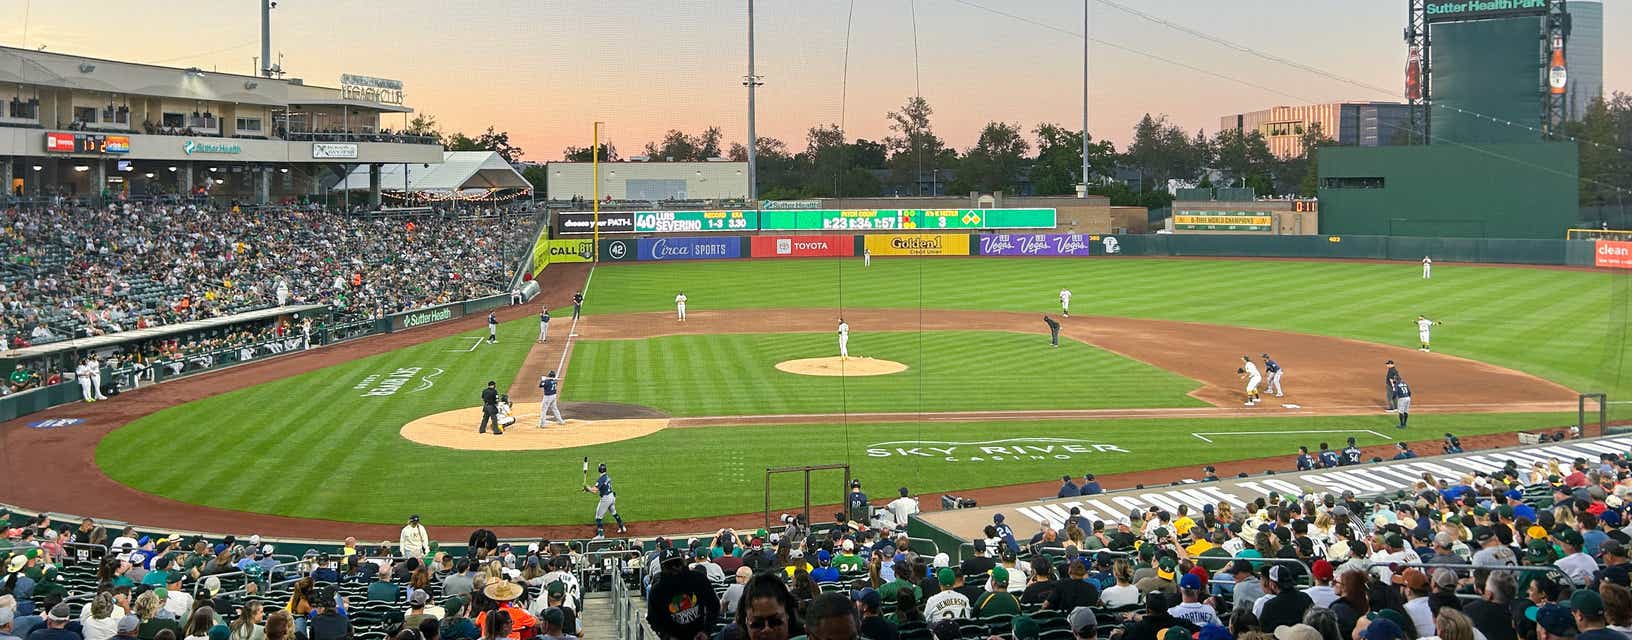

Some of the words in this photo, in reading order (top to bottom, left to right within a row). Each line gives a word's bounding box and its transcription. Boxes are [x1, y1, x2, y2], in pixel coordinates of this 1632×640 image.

[1426, 3, 1467, 14] Sutter
[1468, 0, 1512, 11] Health
[1513, 0, 1545, 8] Park
[637, 214, 656, 229] 40
[656, 211, 675, 220] LUIS
[590, 221, 607, 229] yur
[656, 220, 702, 231] SEVERINO
[709, 220, 724, 228] 1-3
[550, 247, 577, 255] CALL
[580, 242, 592, 253] 811
[652, 239, 689, 259] Circa
[695, 244, 726, 255] SPORTS
[794, 242, 828, 250] TOYOTA
[891, 236, 932, 249] Golden
[981, 236, 1015, 255] Vegas
[1017, 236, 1051, 255] Vegas
[1053, 236, 1088, 255] Vegas
[612, 245, 623, 255] 42
[1599, 243, 1629, 256] clean
[411, 313, 431, 326] Sutter
[431, 307, 452, 322] Health
[866, 446, 957, 457] SKY
[979, 444, 1132, 455] RIVER
[1015, 486, 1247, 533] WELCOME
[1299, 462, 1466, 495] SUTTER
[996, 526, 1013, 538] 24
